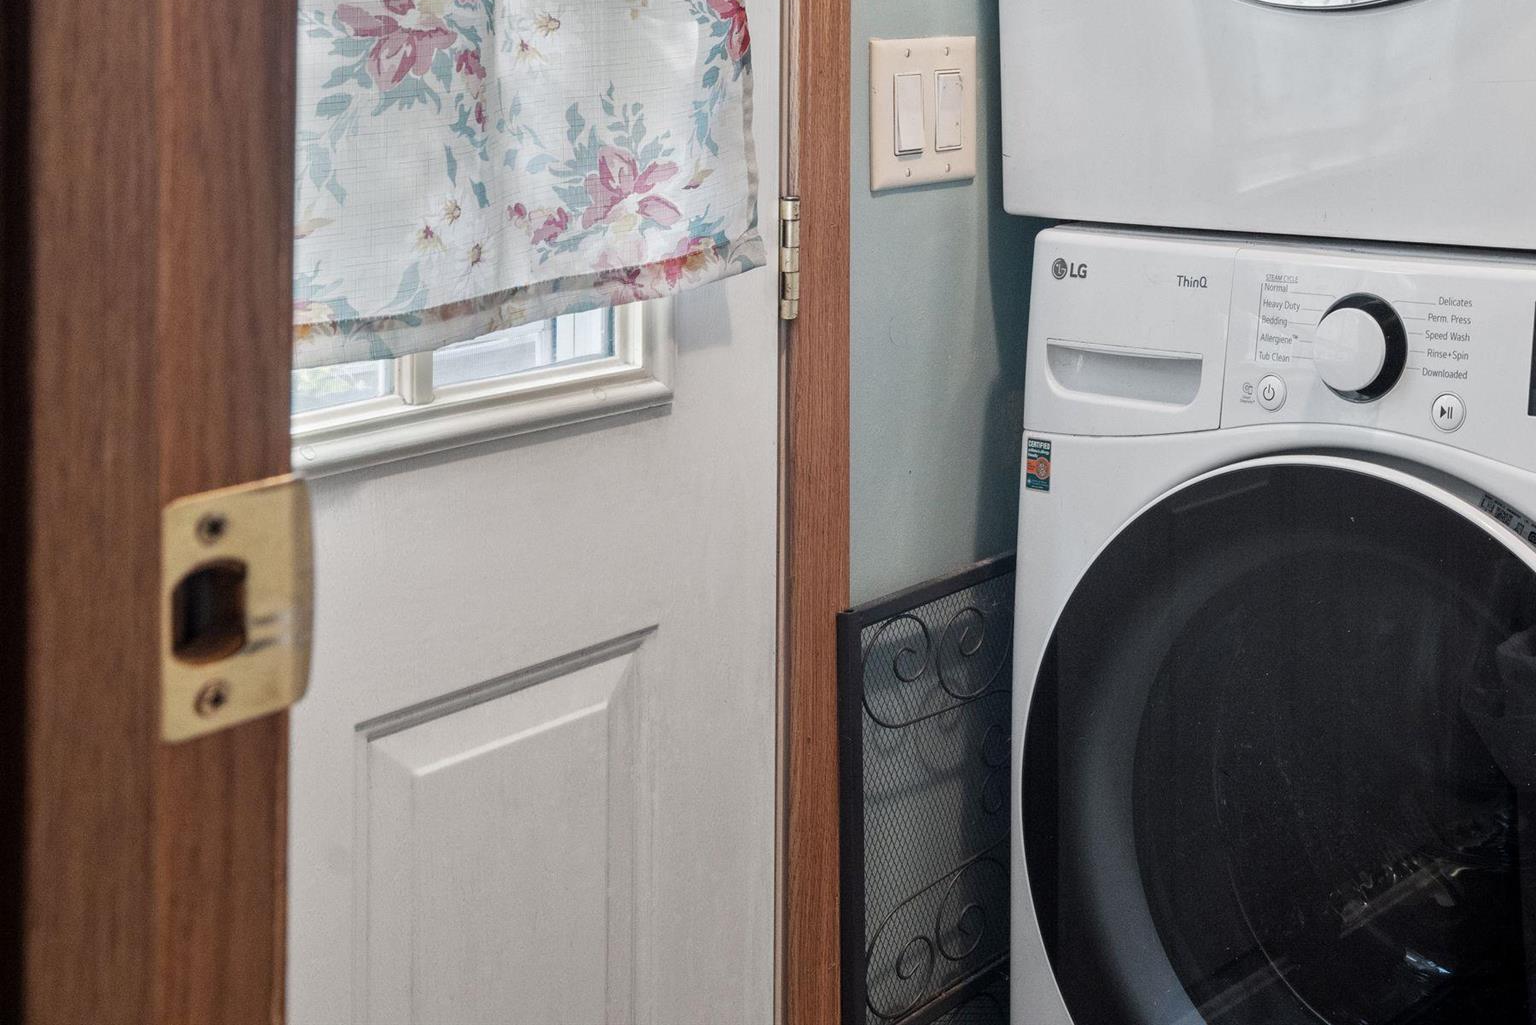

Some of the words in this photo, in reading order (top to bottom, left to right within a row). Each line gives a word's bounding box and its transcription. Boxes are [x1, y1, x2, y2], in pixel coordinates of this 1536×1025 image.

[1070, 262, 1088, 279] LG
[1177, 275, 1208, 288] ThinQ
[1264, 283, 1289, 293] Normal
[1262, 299, 1284, 311] Heavy
[1284, 301, 1301, 313] Duty
[1438, 296, 1473, 307] Delicates
[1261, 315, 1289, 328] Bedding
[1427, 313, 1449, 324] Perm.
[1450, 314, 1472, 325] Press
[1425, 329, 1448, 342] Speed
[1449, 332, 1471, 343] Wash
[1259, 351, 1271, 361] Tub
[1271, 352, 1290, 364] Clean
[1427, 348, 1469, 362] Rinse+Spin
[1422, 367, 1468, 380] Downloaded
